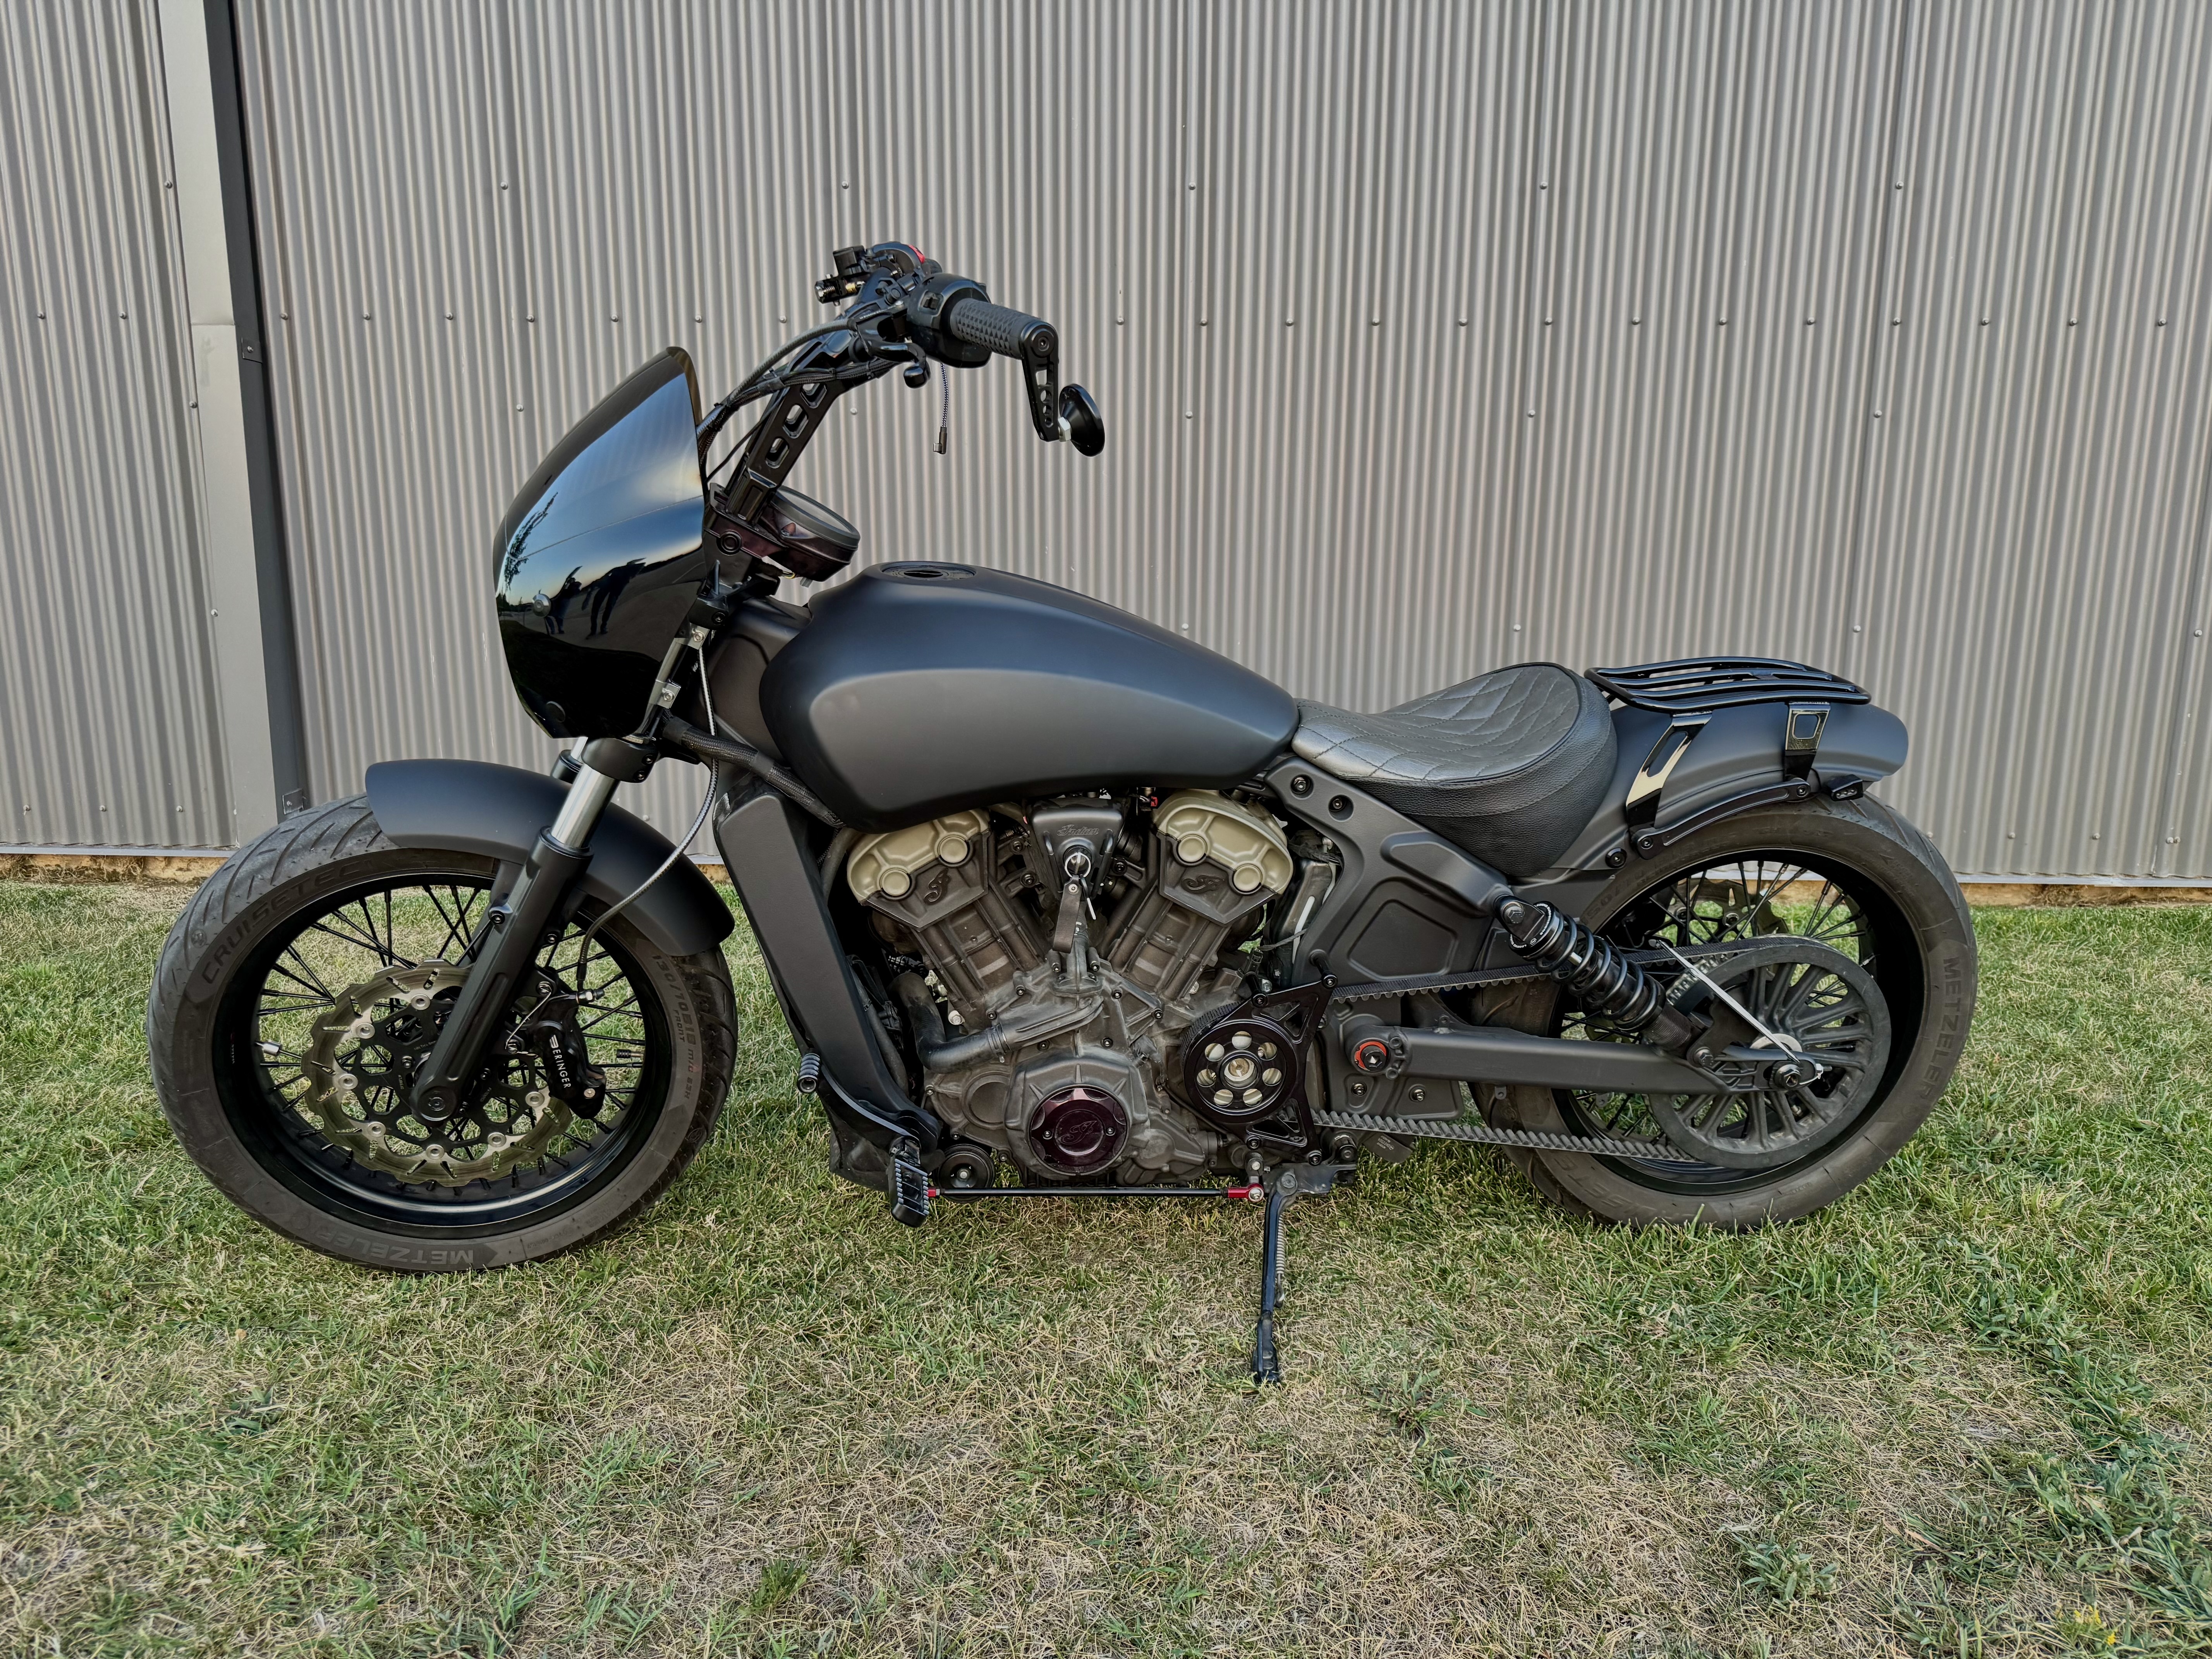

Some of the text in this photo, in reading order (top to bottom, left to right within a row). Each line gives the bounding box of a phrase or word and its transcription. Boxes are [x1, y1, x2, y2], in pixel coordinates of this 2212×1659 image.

[1057, 824, 1099, 836] Indian
[201, 859, 360, 984] CRUISETEC
[673, 1009, 685, 1042] FRONT
[1920, 957, 1962, 1099] METZELER
[549, 1034, 571, 1088] BERINGER
[314, 1228, 474, 1264] METZELER
